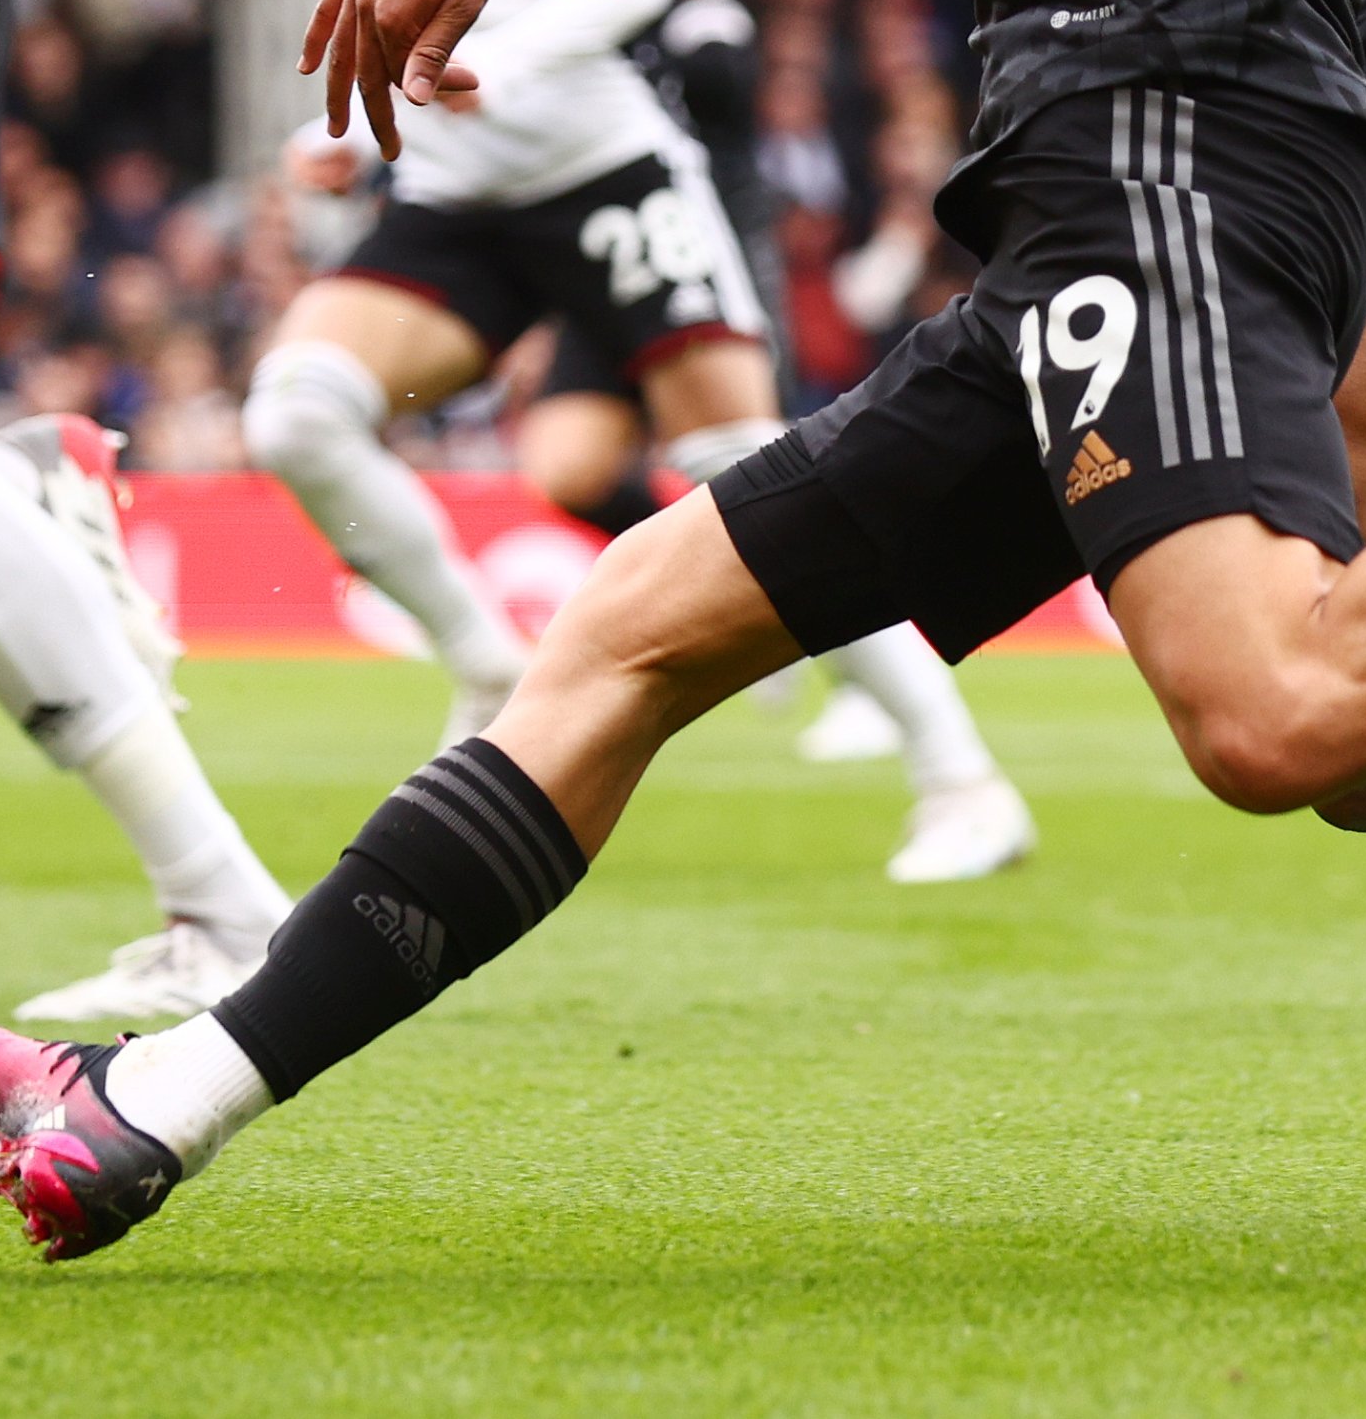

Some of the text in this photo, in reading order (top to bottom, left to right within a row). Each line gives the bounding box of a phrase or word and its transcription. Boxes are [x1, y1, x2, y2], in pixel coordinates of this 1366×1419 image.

[578, 186, 715, 309] 28
[1015, 274, 1138, 458] 19
[1064, 456, 1132, 507] adidas
